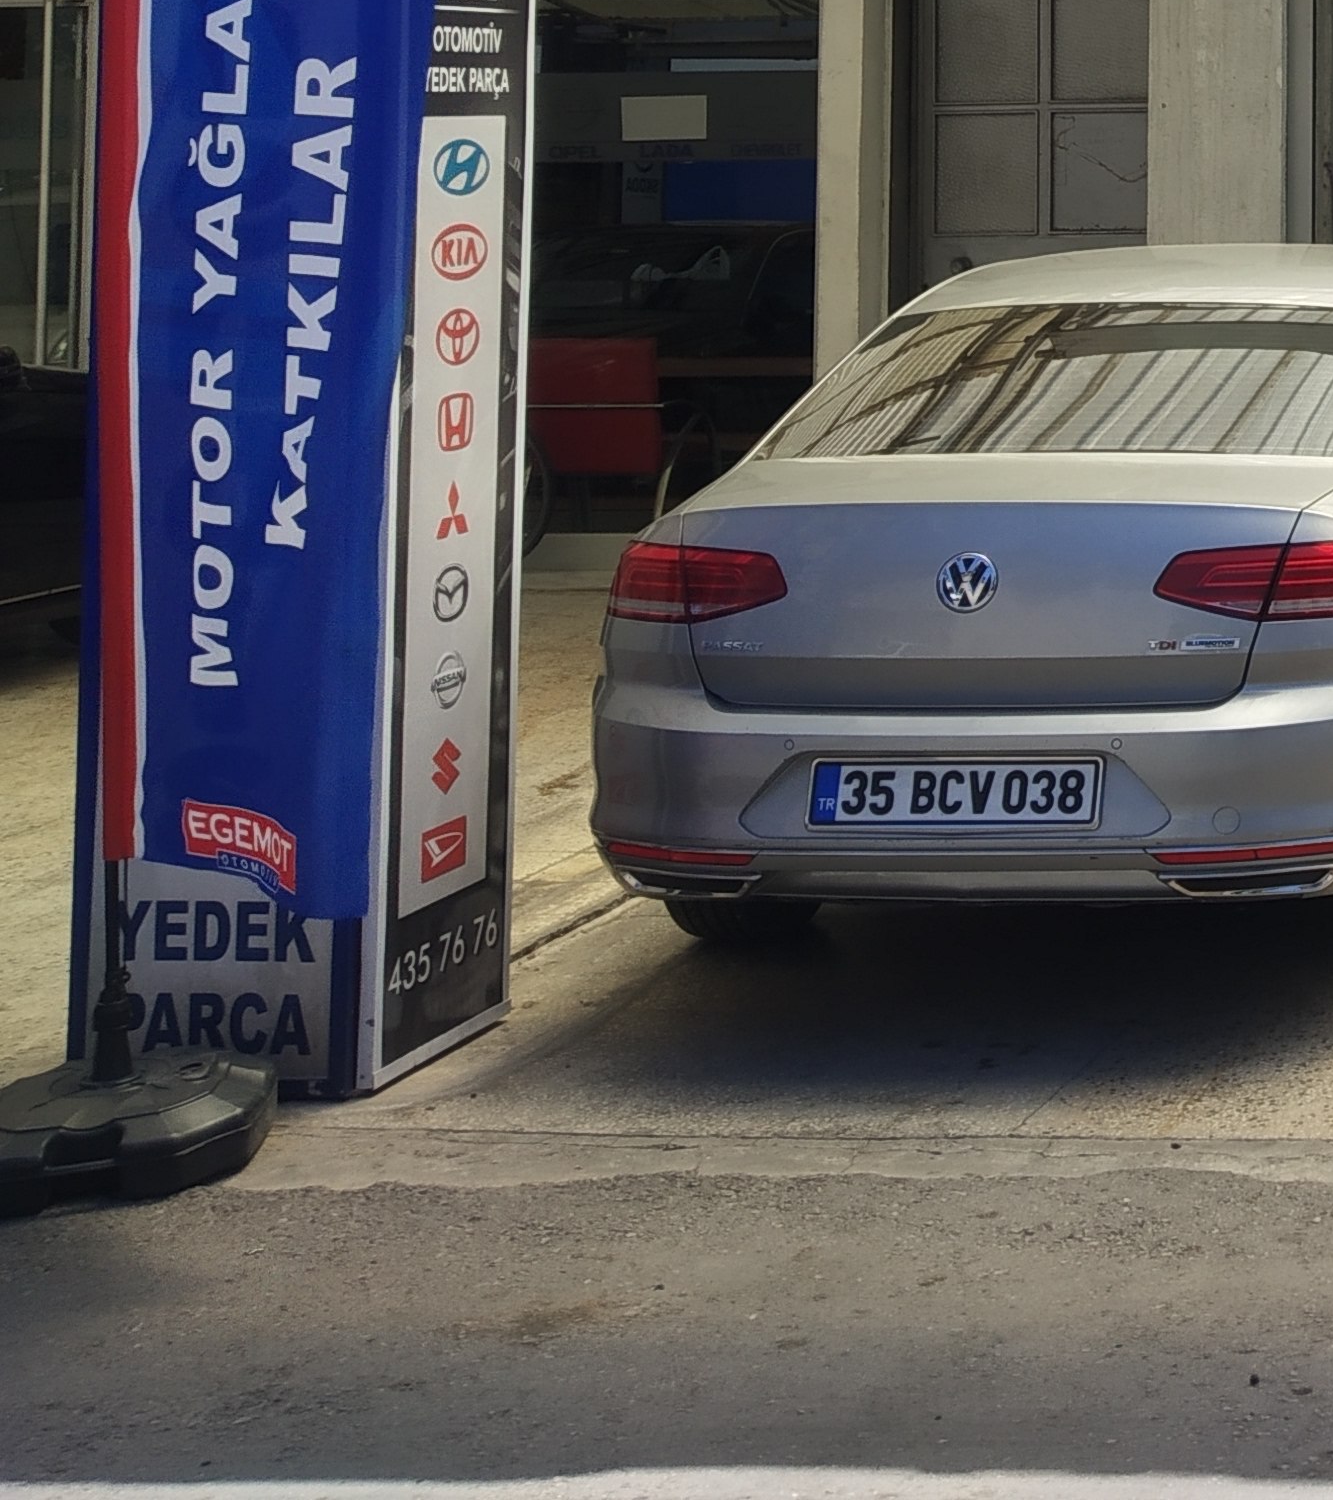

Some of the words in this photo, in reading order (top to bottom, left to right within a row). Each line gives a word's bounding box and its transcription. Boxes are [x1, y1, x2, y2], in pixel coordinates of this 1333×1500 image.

[432, 22, 502, 53] OTOMOTİV
[468, 66, 510, 100] PARÇA
[265, 56, 358, 551] KATKILAR
[189, 347, 240, 687] MOTOR
[702, 640, 764, 652] PASSAT
[1148, 640, 1177, 651] TDI
[817, 797, 835, 811] TR
[841, 771, 896, 816] 35
[910, 771, 996, 815] BCV
[1002, 769, 1086, 815] 038
[188, 809, 293, 872] EGEMOT
[388, 938, 431, 996] 435
[439, 924, 465, 973] 76
[473, 906, 498, 956] 76
